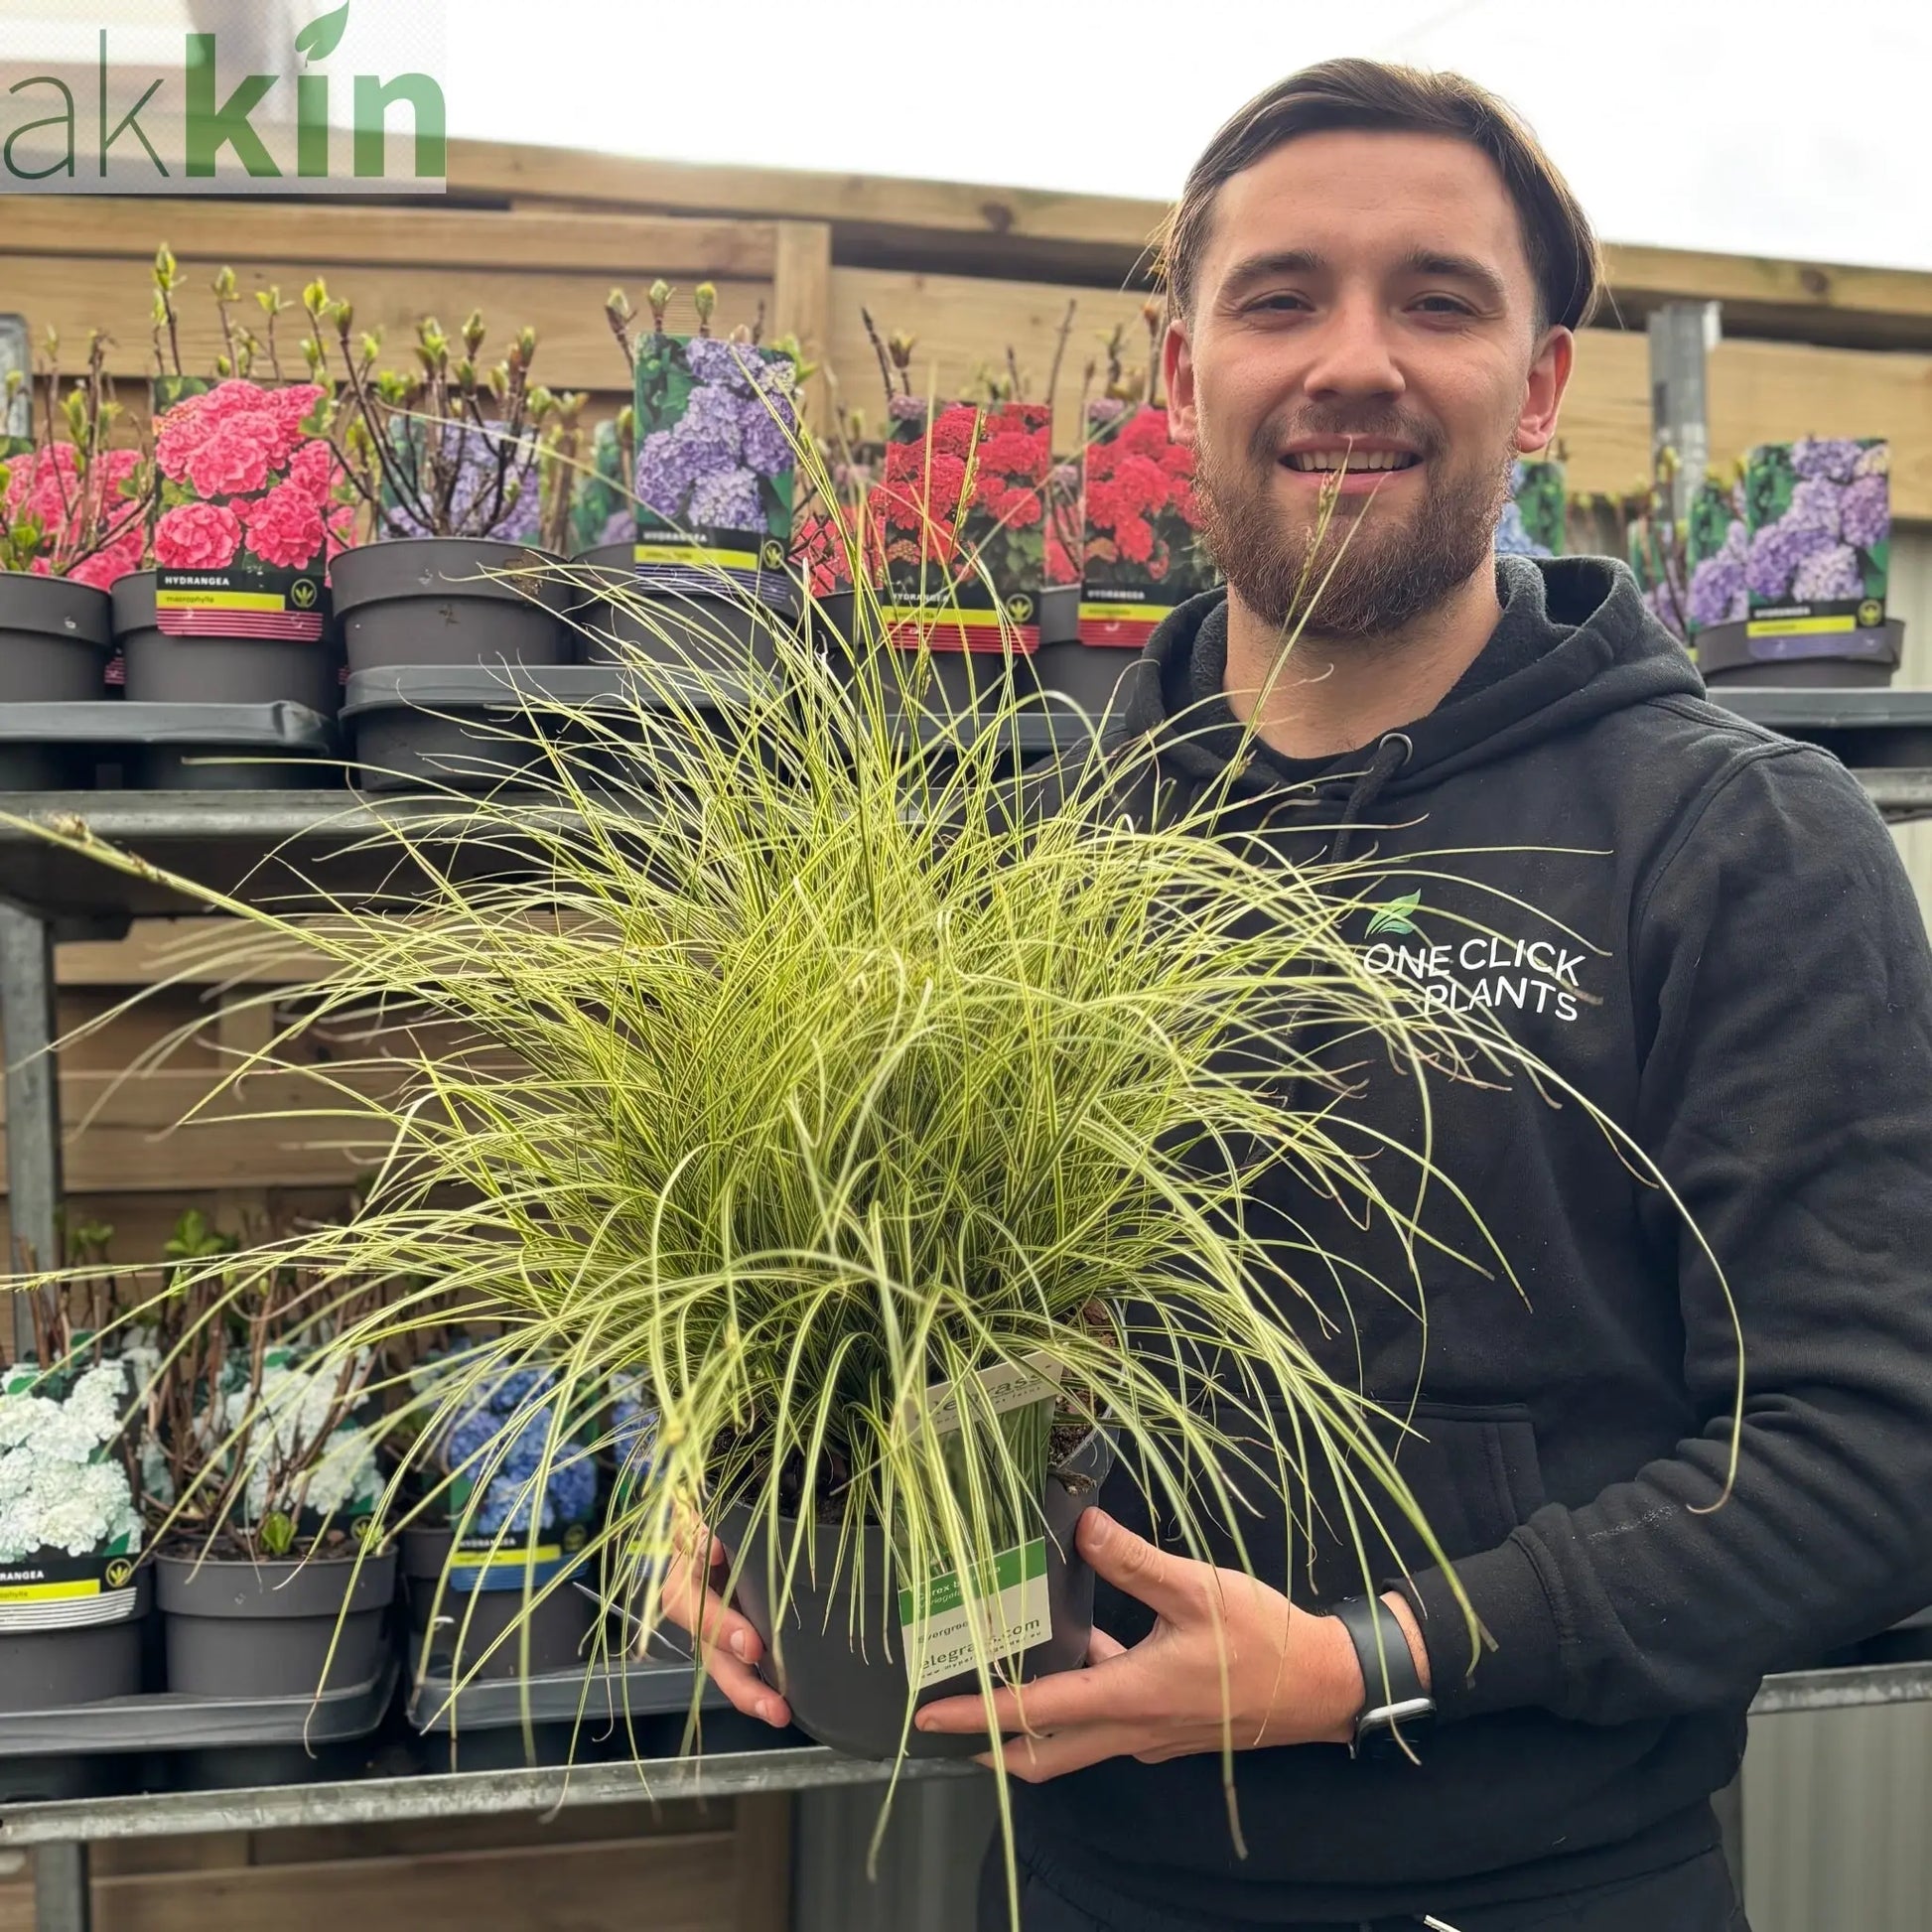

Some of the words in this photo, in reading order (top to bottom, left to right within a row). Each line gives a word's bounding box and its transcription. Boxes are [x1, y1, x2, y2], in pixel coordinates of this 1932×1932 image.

[165, 576, 230, 587] HYDRANGEA
[1363, 942, 1452, 979] ONE
[1459, 936, 1586, 987] CLICK
[1424, 975, 1578, 1022] PLANTS
